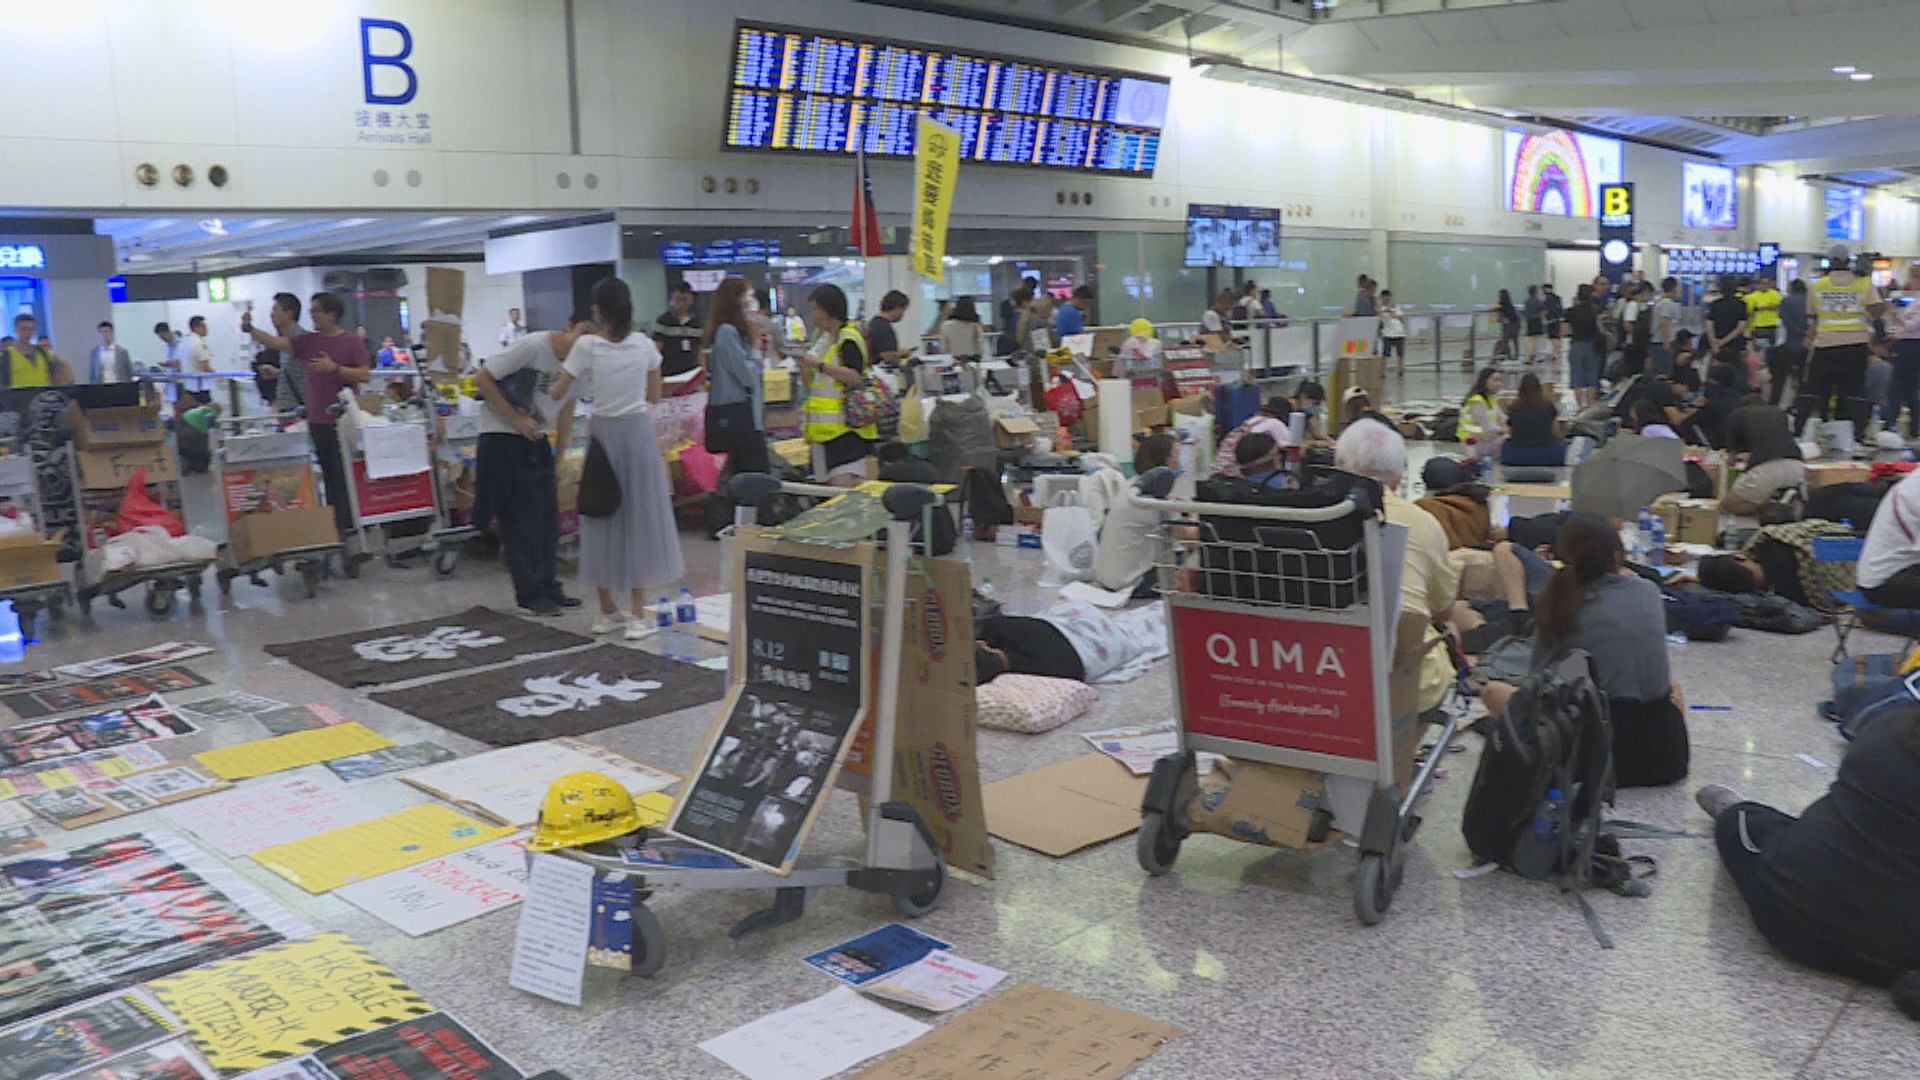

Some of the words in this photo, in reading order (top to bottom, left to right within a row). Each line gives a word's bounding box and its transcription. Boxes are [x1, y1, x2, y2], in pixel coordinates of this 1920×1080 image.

[360, 17, 418, 105] B
[354, 110, 432, 129] 接機大堂
[358, 131, 406, 144] Arrivals
[407, 132, 432, 145] Hall
[1604, 187, 1630, 216] B
[752, 638, 785, 662] 8.12
[1206, 632, 1347, 679] QIMA
[302, 949, 363, 978] HK
[300, 991, 341, 1014] TO
[259, 1013, 309, 1044] HK
